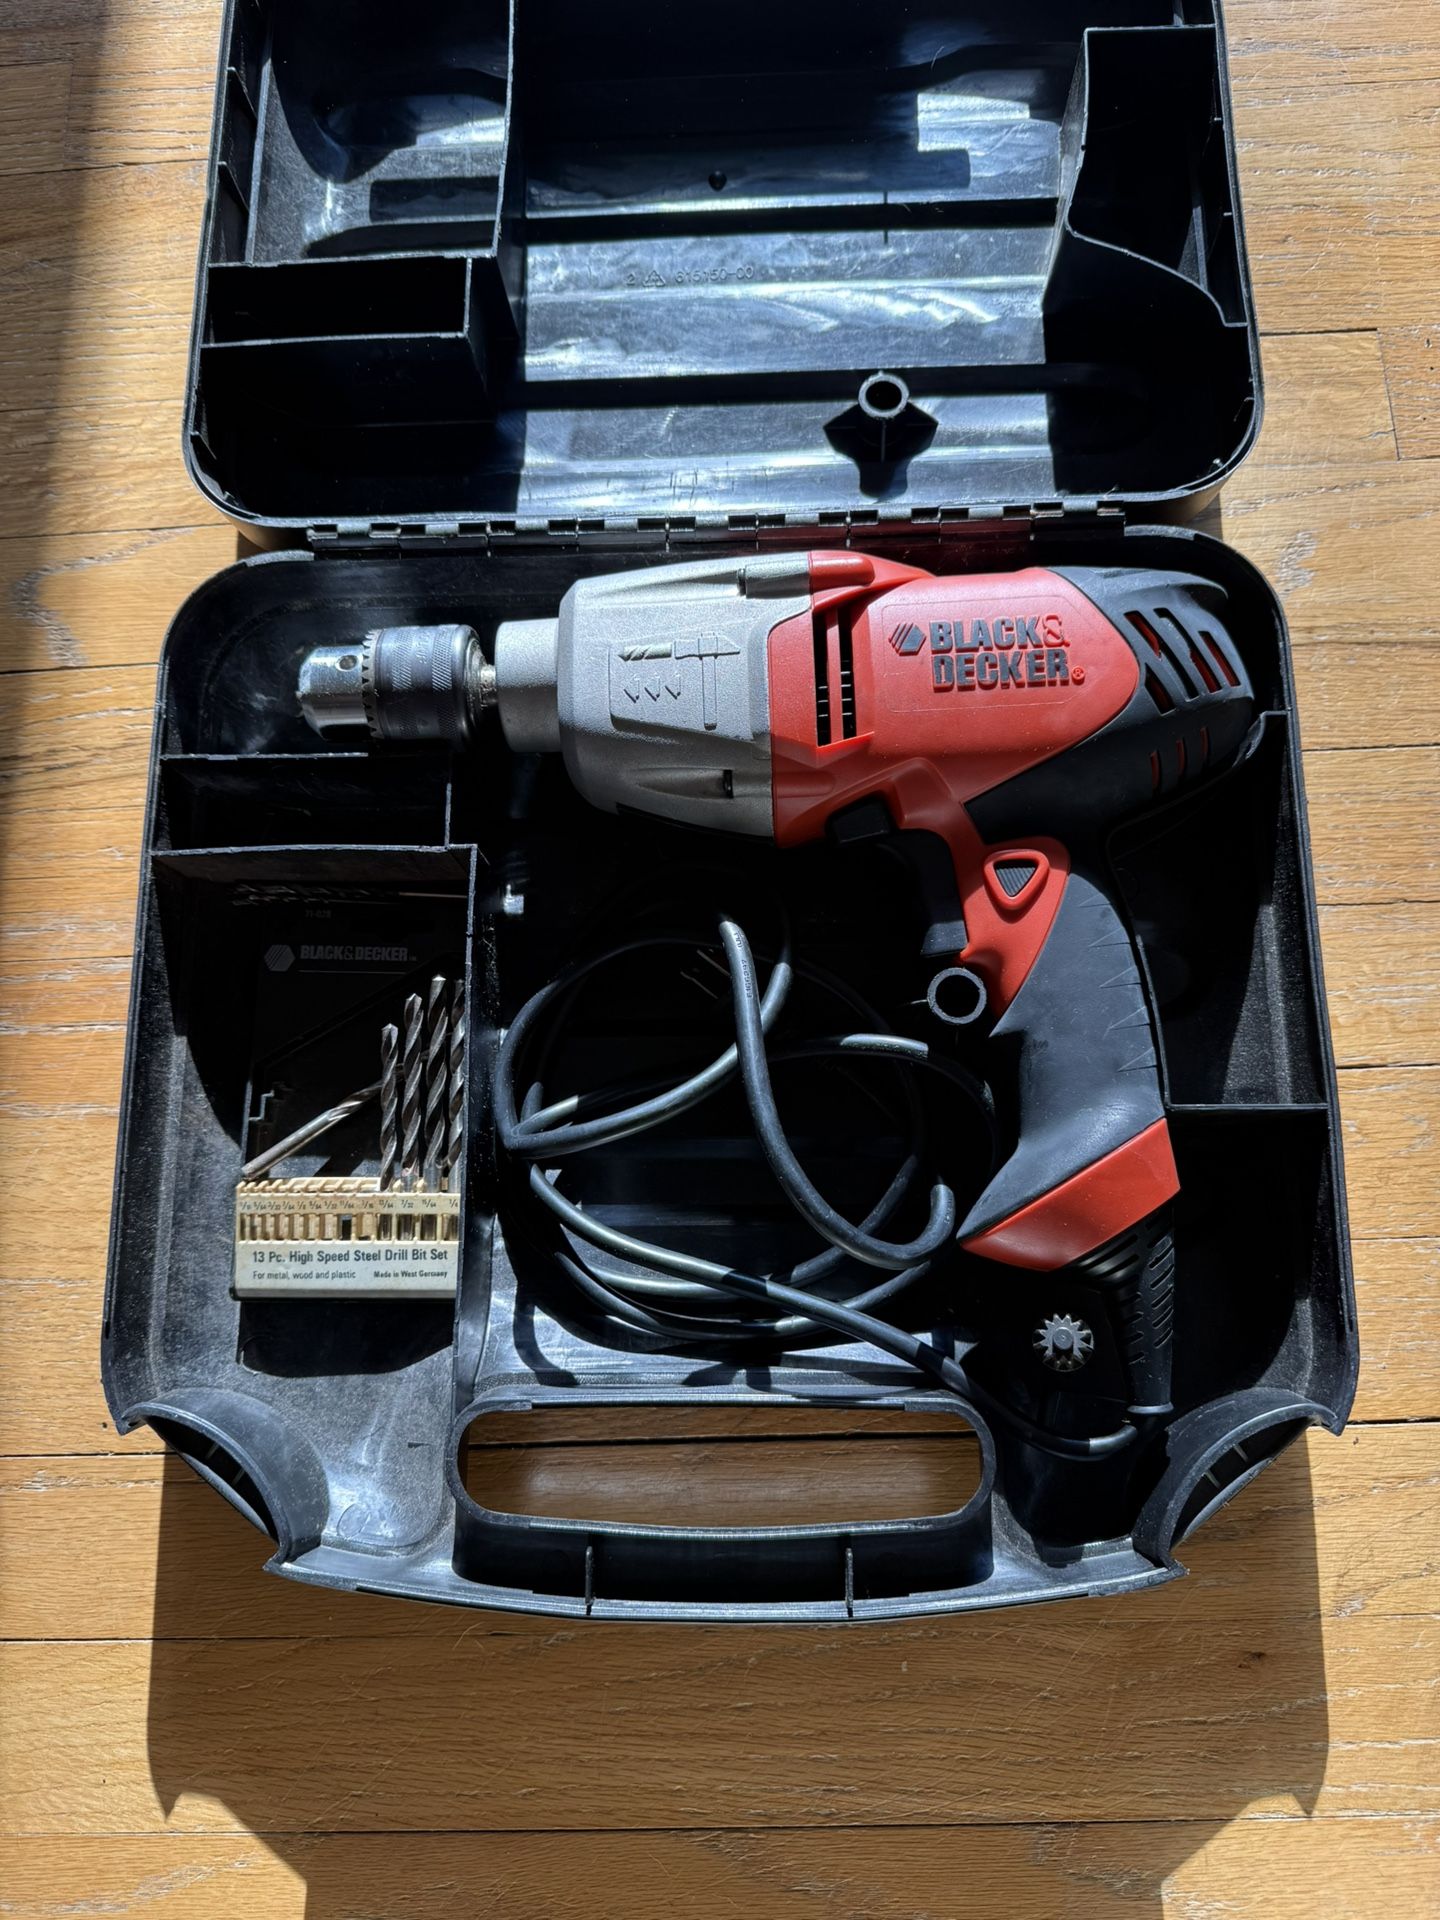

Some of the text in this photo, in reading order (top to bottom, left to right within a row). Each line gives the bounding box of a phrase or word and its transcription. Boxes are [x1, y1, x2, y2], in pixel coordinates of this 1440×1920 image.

[253, 1248, 448, 1265] 13 Pc. High Speed Steel Drill Bit Set
[253, 1271, 264, 1279] For
[293, 1270, 312, 1279] wood
[315, 1270, 329, 1279] and
[331, 1270, 356, 1281] plastic
[374, 1270, 448, 1280] Made in West Germany
